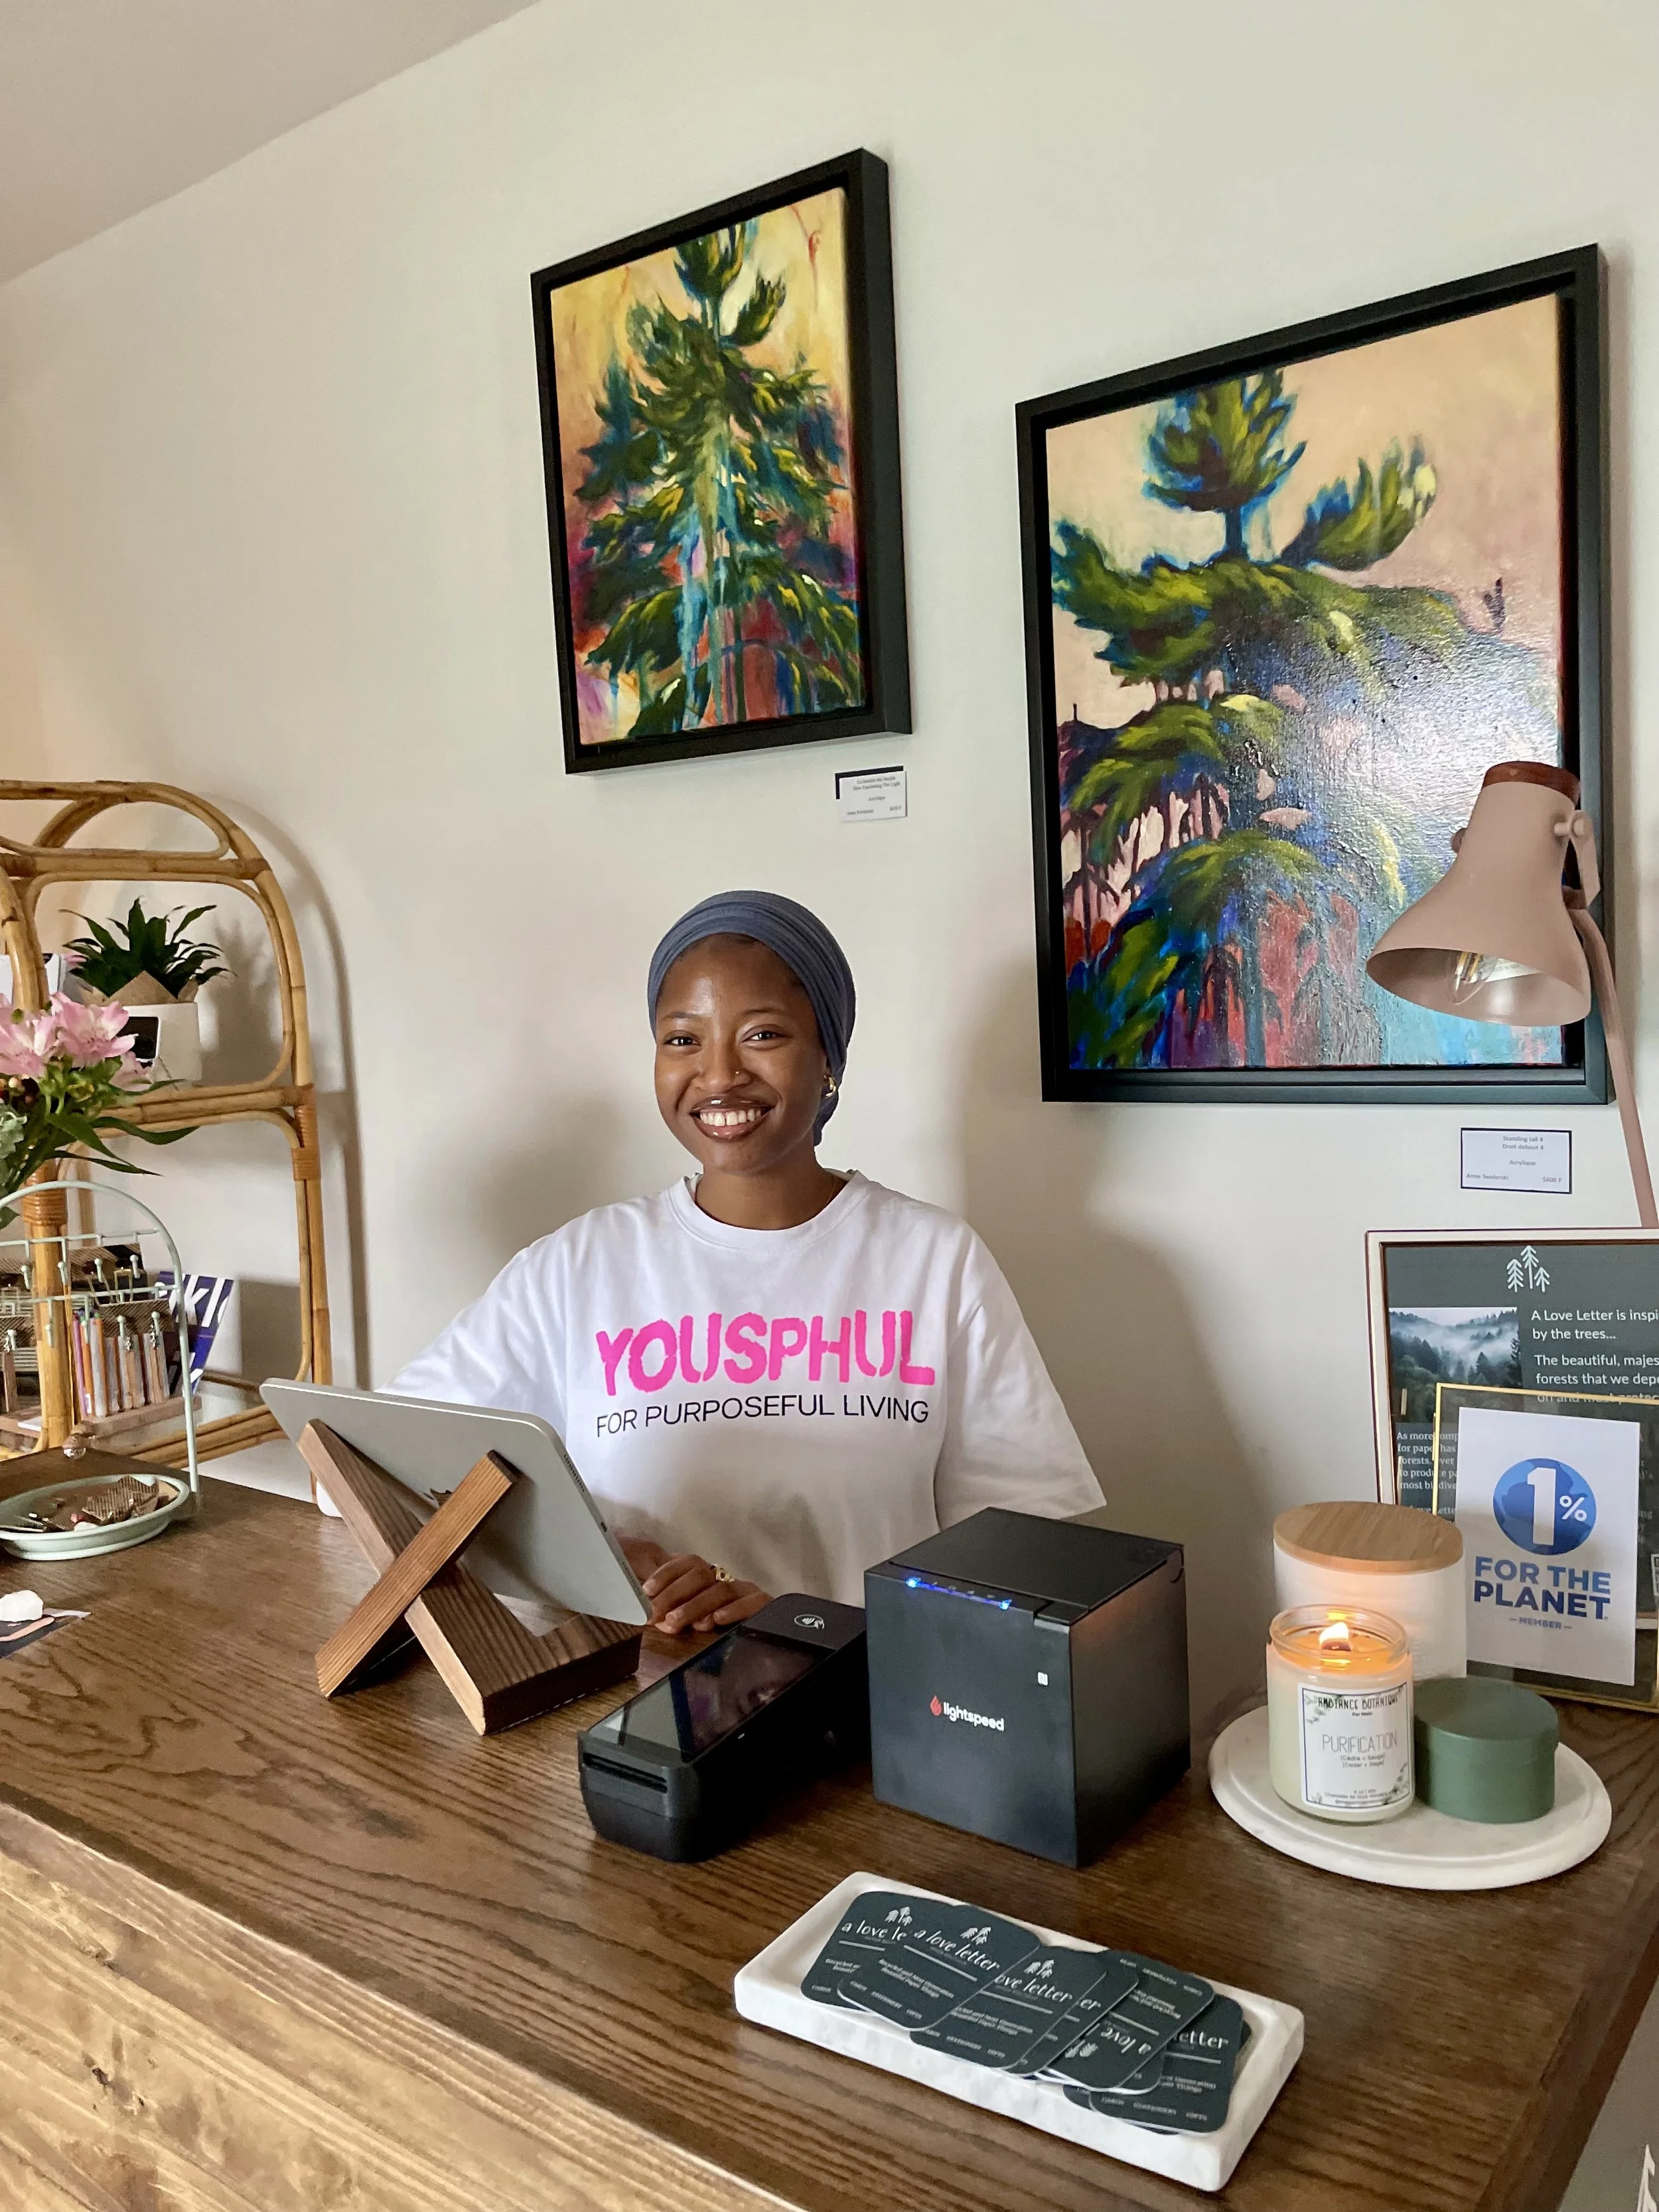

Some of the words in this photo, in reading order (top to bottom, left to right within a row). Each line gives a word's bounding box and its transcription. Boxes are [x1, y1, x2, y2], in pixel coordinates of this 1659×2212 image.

[1531, 1310, 1541, 1321] A
[1544, 1309, 1573, 1321] Love
[1577, 1309, 1613, 1321] Letter
[1617, 1309, 1626, 1321] is
[1532, 1328, 1547, 1341] by
[1550, 1328, 1571, 1339] the
[1575, 1329, 1617, 1339] trees...
[595, 1309, 936, 1396] YOUSPHUL
[1534, 1355, 1558, 1366] The
[1561, 1354, 1621, 1367] beautiful,
[1536, 1372, 1579, 1384] forests
[1582, 1372, 1607, 1384] that
[1610, 1375, 1629, 1384] we
[1632, 1372, 1659, 1386] dep
[597, 1408, 638, 1438] FOR
[645, 1394, 835, 1427] PURPOSEFUL
[843, 1394, 929, 1424] LIVING
[1398, 1443, 1411, 1452] for
[1440, 1443, 1456, 1452] has
[1475, 1555, 1540, 1584] FOR
[1548, 1565, 1611, 1595] THE
[1473, 1581, 1611, 1620] PLANET
[1519, 1617, 1561, 1630] MEMBER
[1319, 1697, 1358, 1710] AMBIANCE
[1362, 1692, 1398, 1710] BOTANIQUE
[943, 1702, 1004, 1732] lightspeed
[1323, 1730, 1397, 1753] PURIFICATION
[841, 1922, 852, 1932] a
[856, 1920, 889, 1939] love
[914, 1929, 926, 1939] a
[926, 1931, 957, 1952] love
[955, 1943, 1000, 1970] letter
[994, 1974, 1023, 1990] ove
[1023, 1978, 1072, 2002] letter
[1100, 2027, 1137, 2053] love
[1138, 2043, 1151, 2055] a
